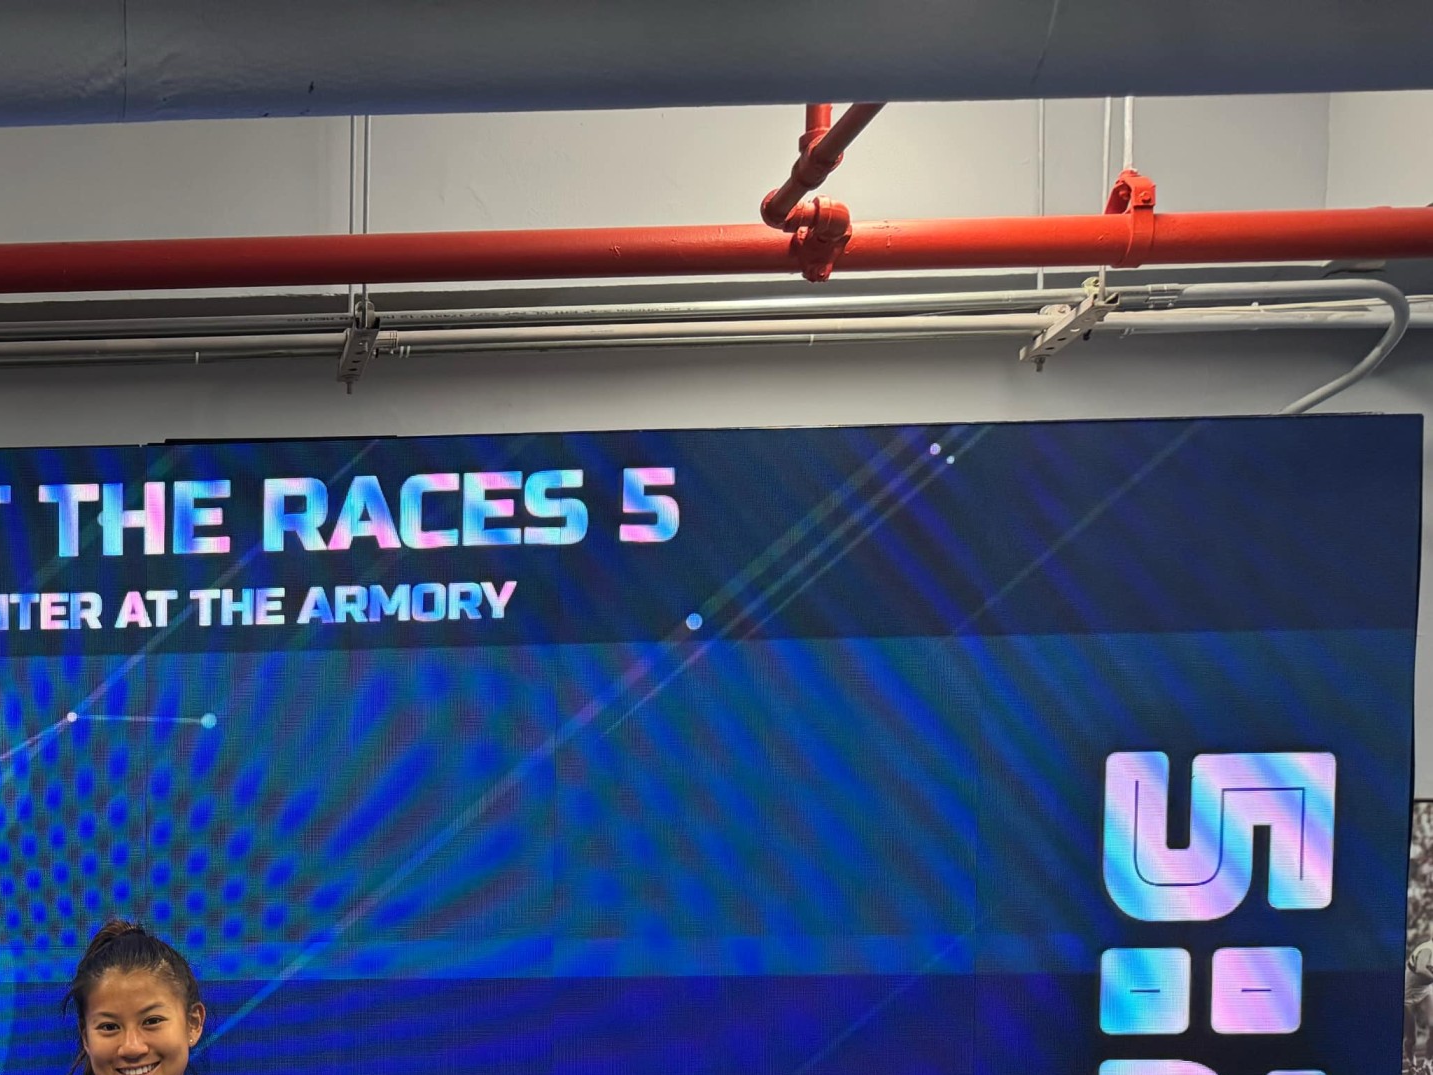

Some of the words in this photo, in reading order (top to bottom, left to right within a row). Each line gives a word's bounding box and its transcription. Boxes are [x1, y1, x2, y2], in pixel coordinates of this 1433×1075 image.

[39, 479, 231, 557] THE
[263, 469, 589, 552] RACES
[619, 467, 680, 543] 5
[114, 590, 178, 629] AT
[189, 587, 285, 627] THE
[297, 581, 518, 624] ARMORY
